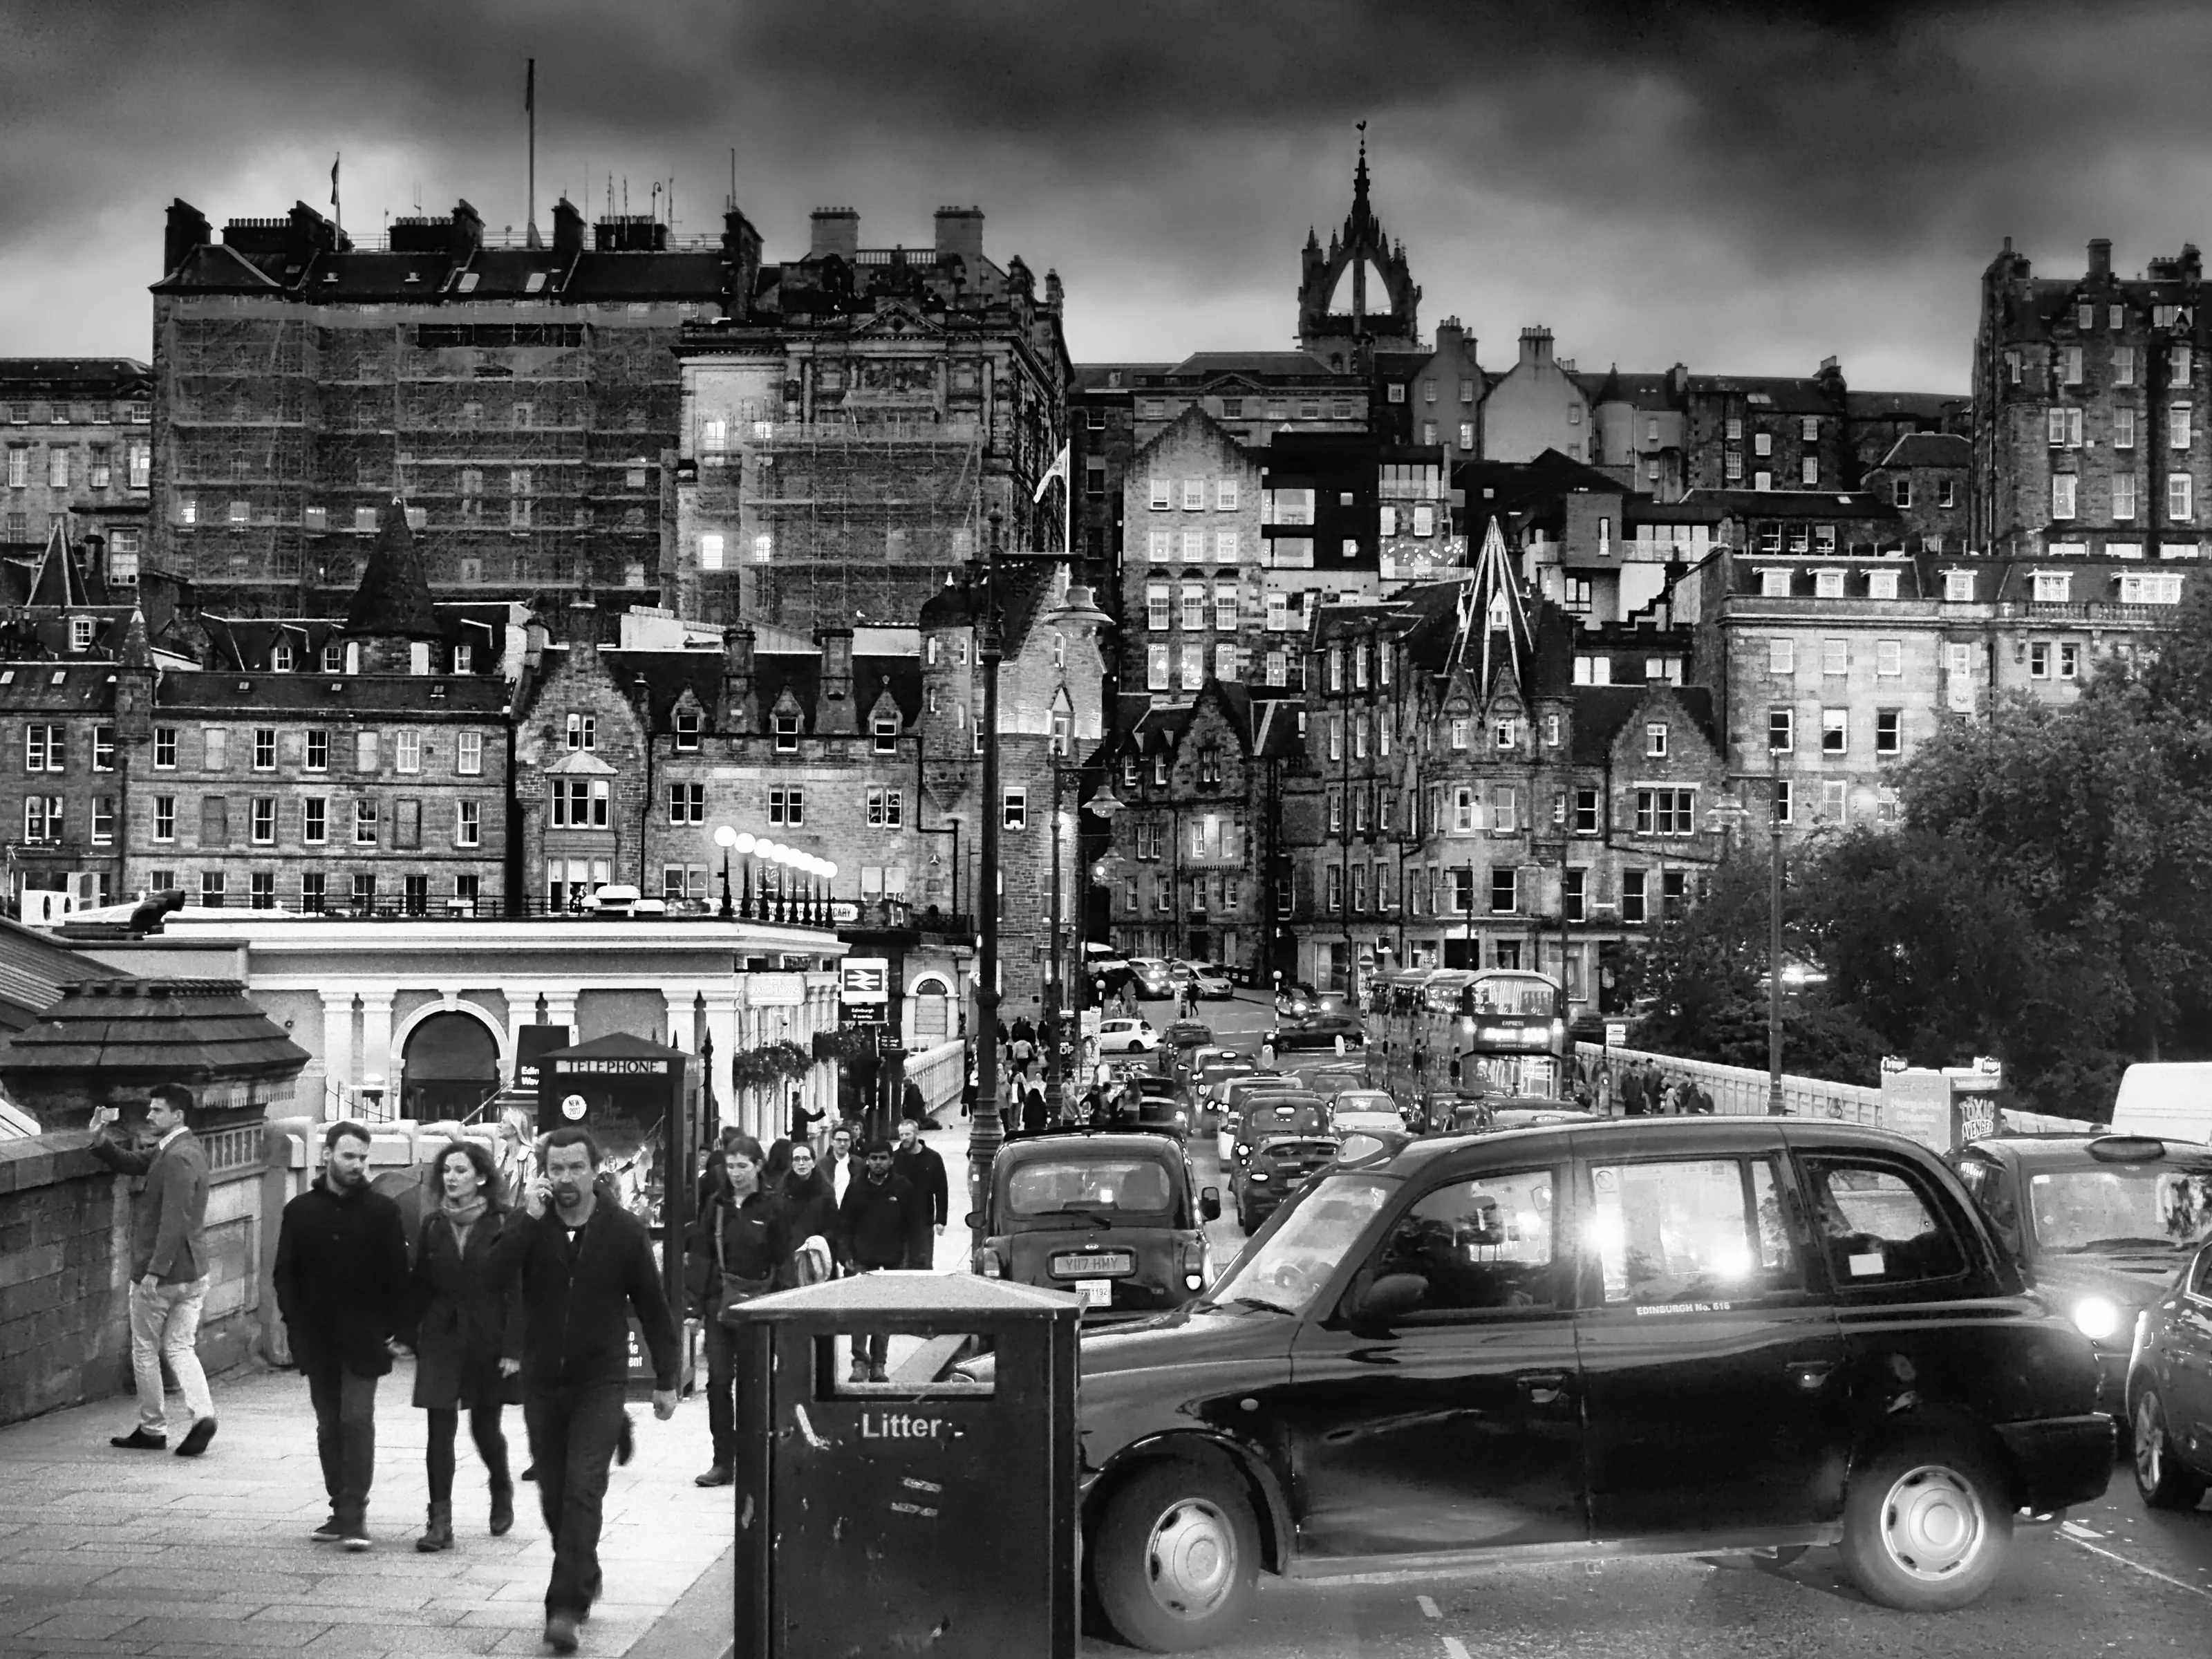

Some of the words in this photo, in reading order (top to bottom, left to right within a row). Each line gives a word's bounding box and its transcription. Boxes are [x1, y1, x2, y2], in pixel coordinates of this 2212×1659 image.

[521, 1066, 539, 1075] Edin
[567, 1060, 659, 1073] TELEPHONE
[521, 1076, 539, 1085] Wav
[1958, 1098, 1995, 1123] TOXIC
[1962, 1120, 1994, 1141] AVENGER
[1094, 1257, 1118, 1271] HMY
[1636, 1304, 1694, 1315] EDINBURGH
[1695, 1303, 1711, 1312] No.
[1713, 1302, 1731, 1311] 616
[863, 1413, 942, 1438] Litter
